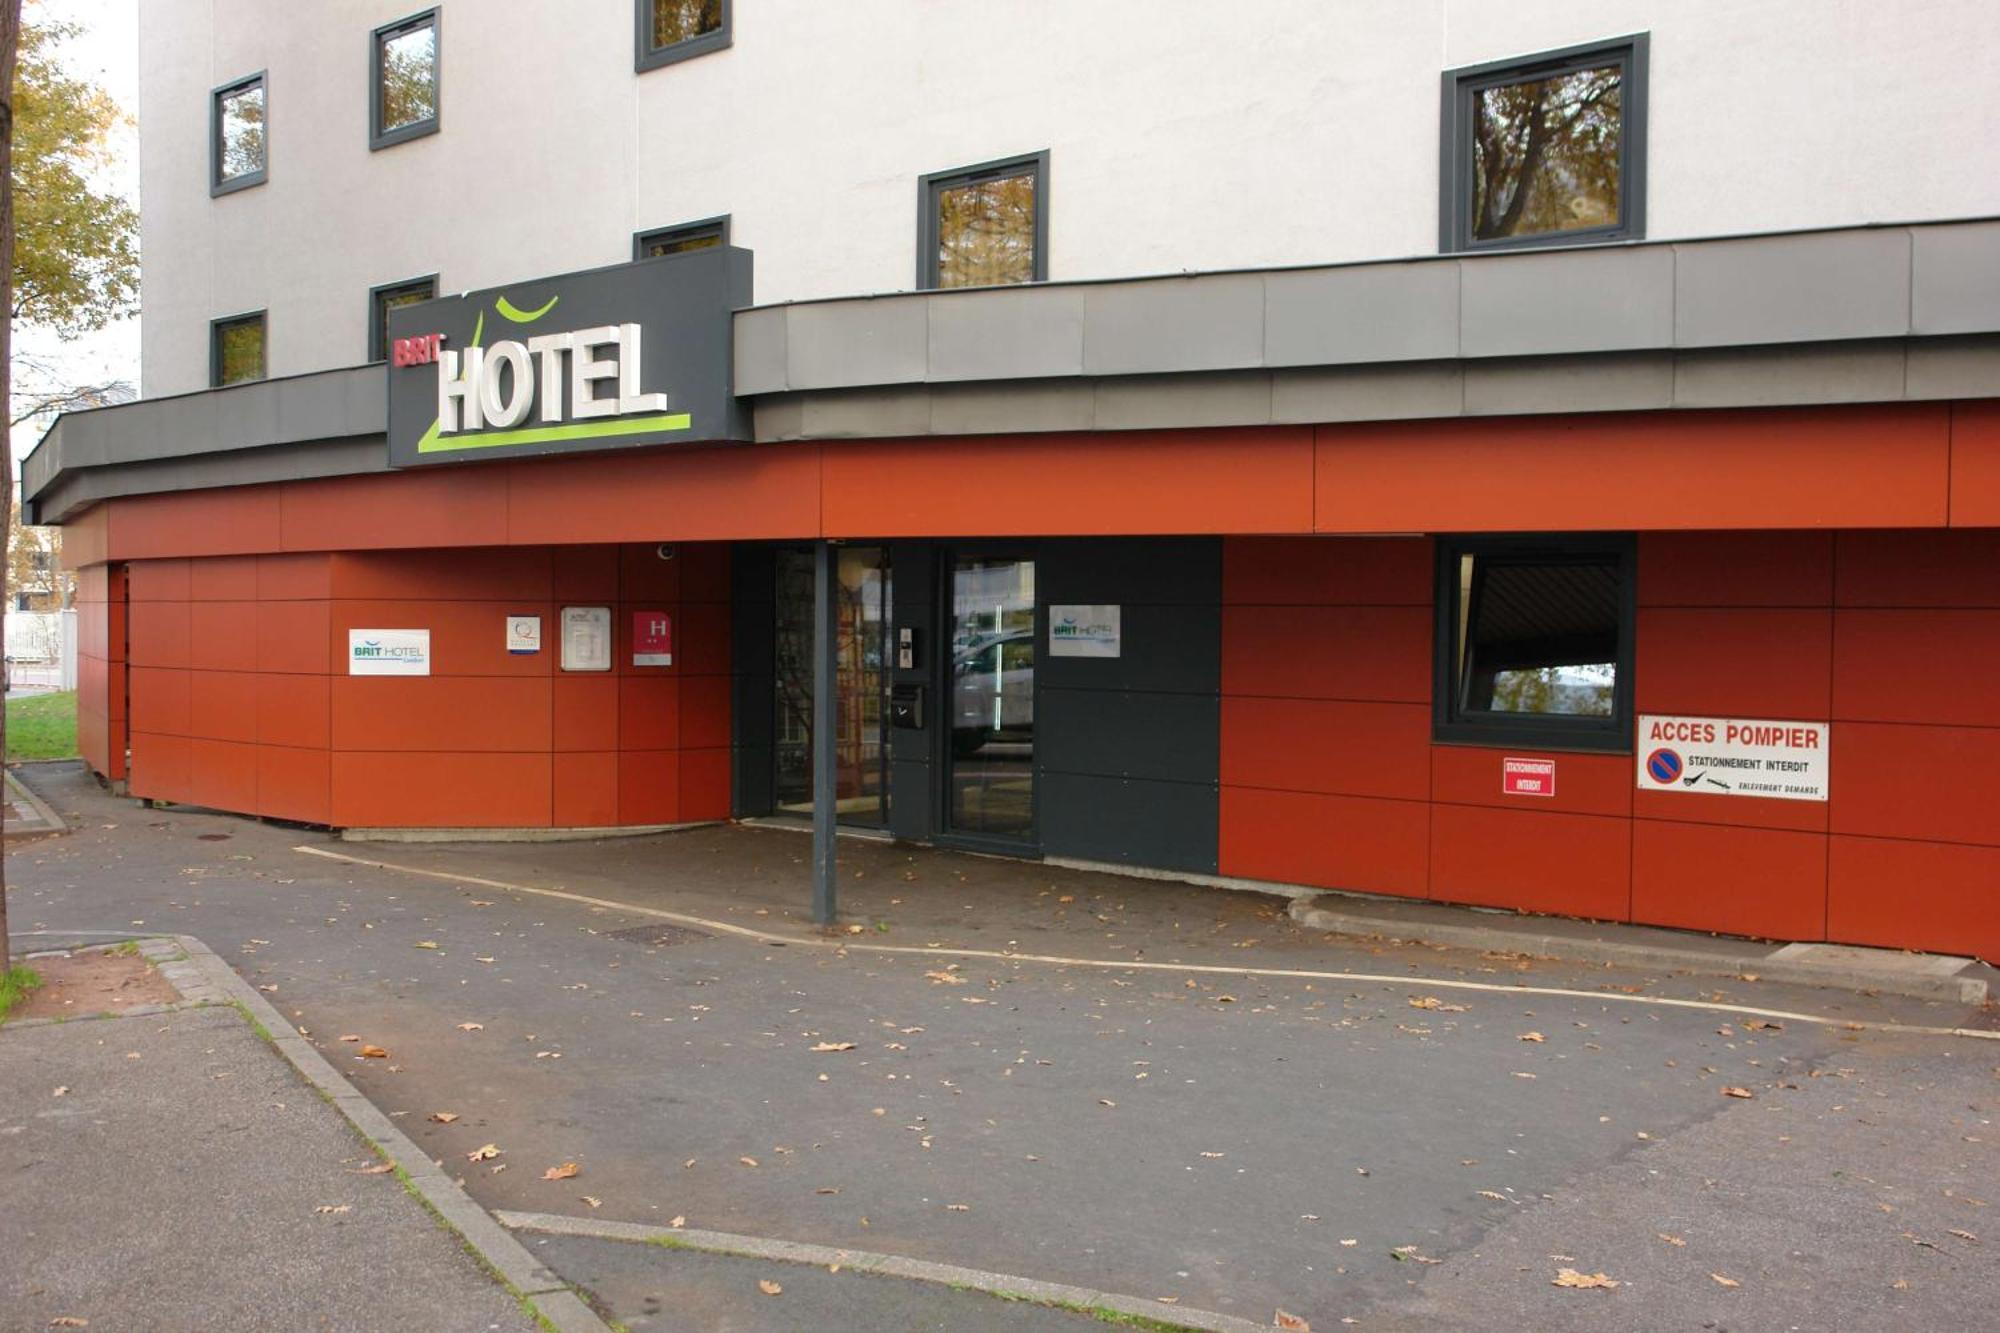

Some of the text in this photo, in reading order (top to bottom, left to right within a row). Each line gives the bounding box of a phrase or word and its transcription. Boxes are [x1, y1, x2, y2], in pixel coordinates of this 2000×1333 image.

[394, 333, 447, 367] BRIT
[438, 323, 667, 432] HOTEL
[1054, 625, 1114, 636] BRIT HOT
[355, 647, 424, 656] BRIT HOTEL
[1651, 722, 1818, 748] ACCES POMPIER
[1506, 762, 1552, 774] STATIONT
[1688, 755, 1809, 773] STATIONNEMENT INTERDIT
[1738, 782, 1781, 792] ENLEVEMENT
